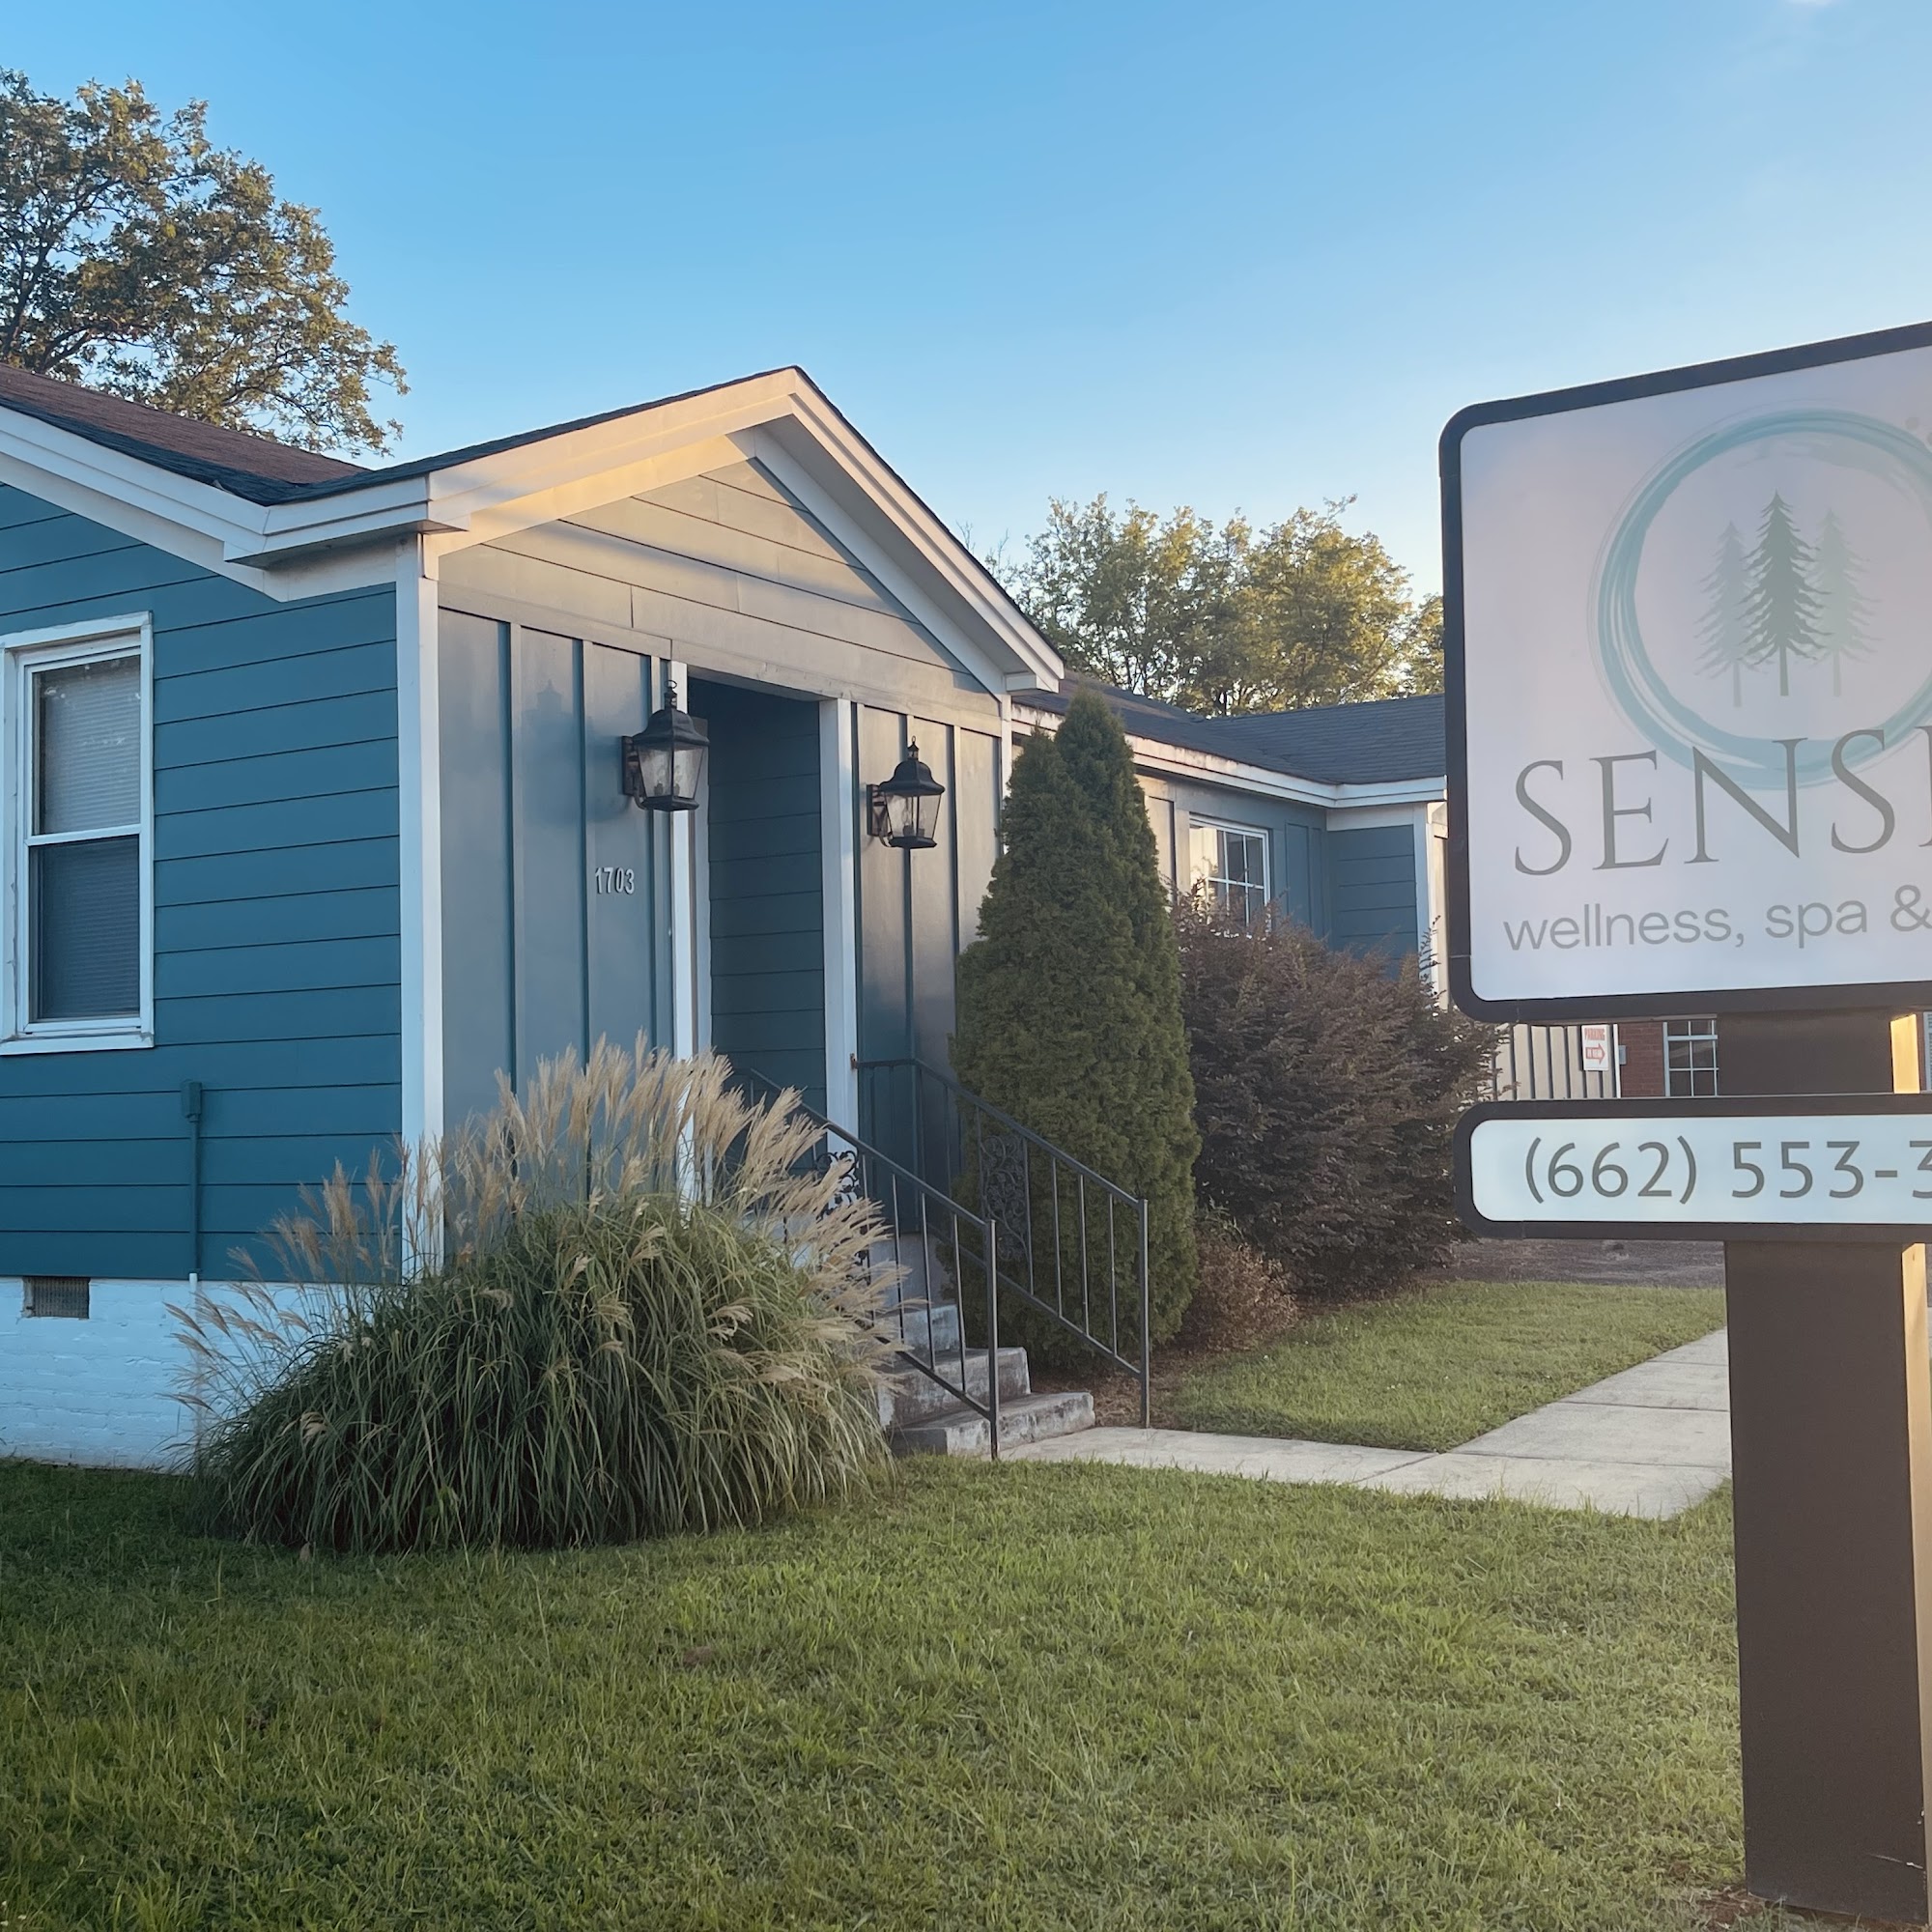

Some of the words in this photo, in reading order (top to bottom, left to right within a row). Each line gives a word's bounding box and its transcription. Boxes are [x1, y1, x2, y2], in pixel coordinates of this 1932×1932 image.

[594, 867, 635, 895] 1703
[1503, 903, 1746, 951] wellness,
[1765, 899, 1868, 949] spa
[1889, 884, 1932, 932] &
[1524, 1136, 1697, 1205] (662)
